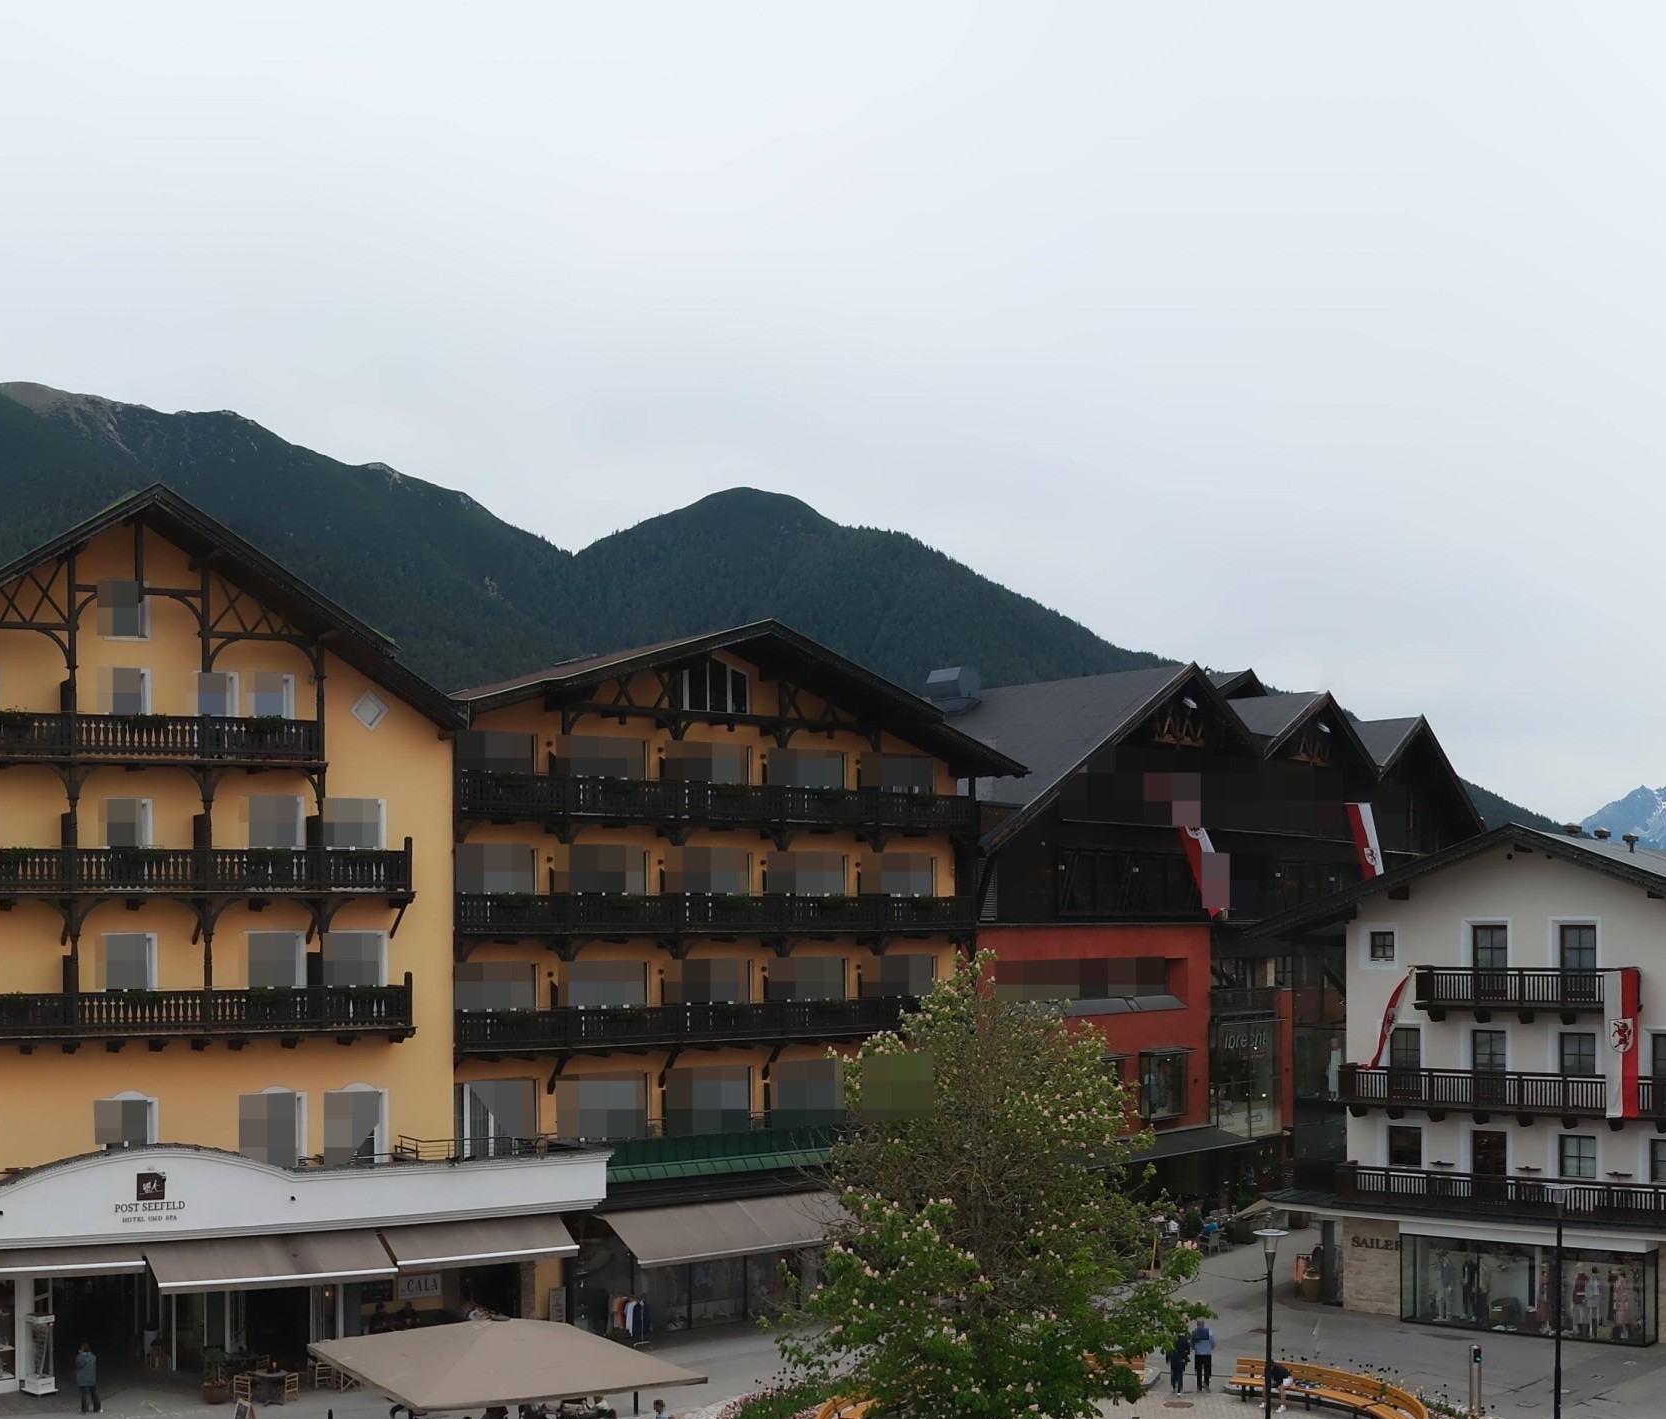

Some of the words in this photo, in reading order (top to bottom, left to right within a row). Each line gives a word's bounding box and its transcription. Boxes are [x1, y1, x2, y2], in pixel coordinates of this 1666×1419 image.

[1224, 1028, 1267, 1050] lbrecht
[114, 1203, 140, 1213] POST
[142, 1201, 186, 1212] SEEFELD
